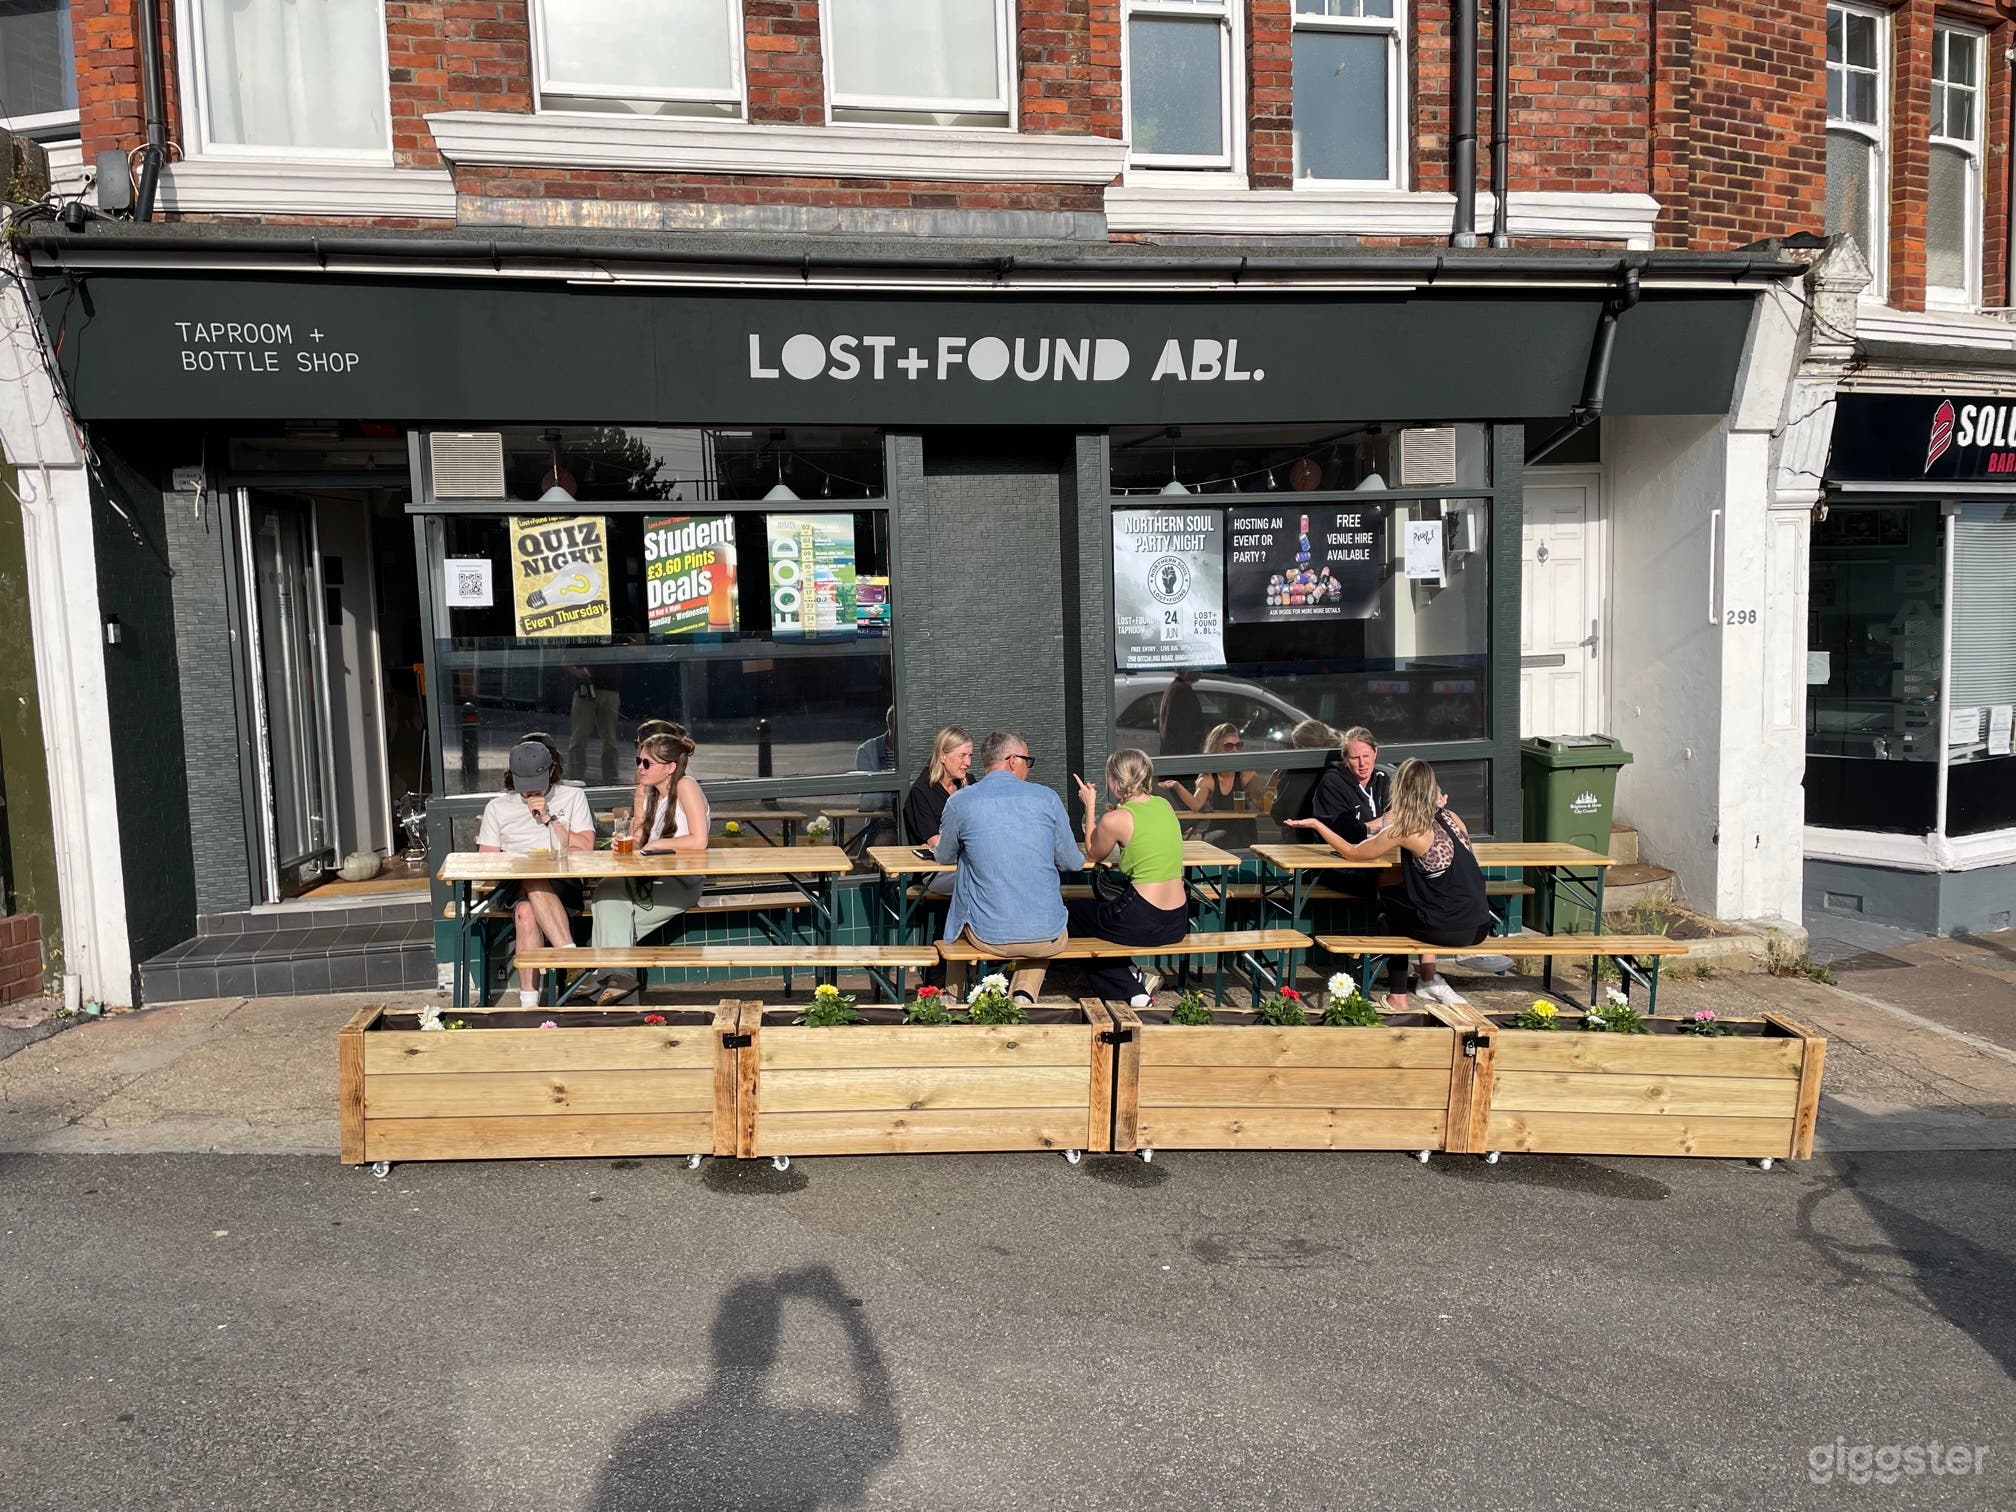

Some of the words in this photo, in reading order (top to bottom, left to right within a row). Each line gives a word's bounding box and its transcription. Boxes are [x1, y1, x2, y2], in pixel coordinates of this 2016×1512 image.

[174, 322, 293, 344] TAPROOM
[309, 328, 325, 343] +
[181, 351, 280, 372] BOTTLE
[296, 352, 360, 373] SHOP
[748, 333, 1131, 382] LOST+FOUND
[1150, 338, 1265, 382] ABL.
[1987, 452, 2016, 473] BAR
[1125, 516, 1185, 534] NORTHERN
[1186, 515, 1216, 532] SOUL
[1234, 518, 1269, 530] HOSTING
[1271, 517, 1283, 529] AN
[1336, 514, 1361, 528] FREE
[517, 522, 602, 558] QUIZ
[644, 514, 734, 561] Student
[1135, 535, 1171, 552] PARTY
[1173, 534, 1206, 551] NIGHT
[1233, 535, 1261, 547] EVENT
[1261, 535, 1273, 546] OR
[1326, 533, 1353, 545] VENUE
[1354, 532, 1373, 544] HIRE
[521, 545, 603, 578] NIGHT
[647, 556, 682, 580] £3.60
[684, 550, 716, 570] Pints
[1233, 551, 1261, 563] PARTY
[1326, 549, 1370, 561] AVAILABLE
[647, 569, 713, 610] Deals
[771, 538, 802, 628] FOOD
[524, 614, 555, 631] Every
[556, 602, 605, 624] Thursday
[649, 614, 672, 628] Sunday
[676, 605, 709, 621] Wednesday
[1193, 619, 1217, 627] FOUND
[1726, 609, 1757, 625] 298
[1117, 626, 1146, 635] TAPROOM
[1164, 627, 1178, 639] JUN
